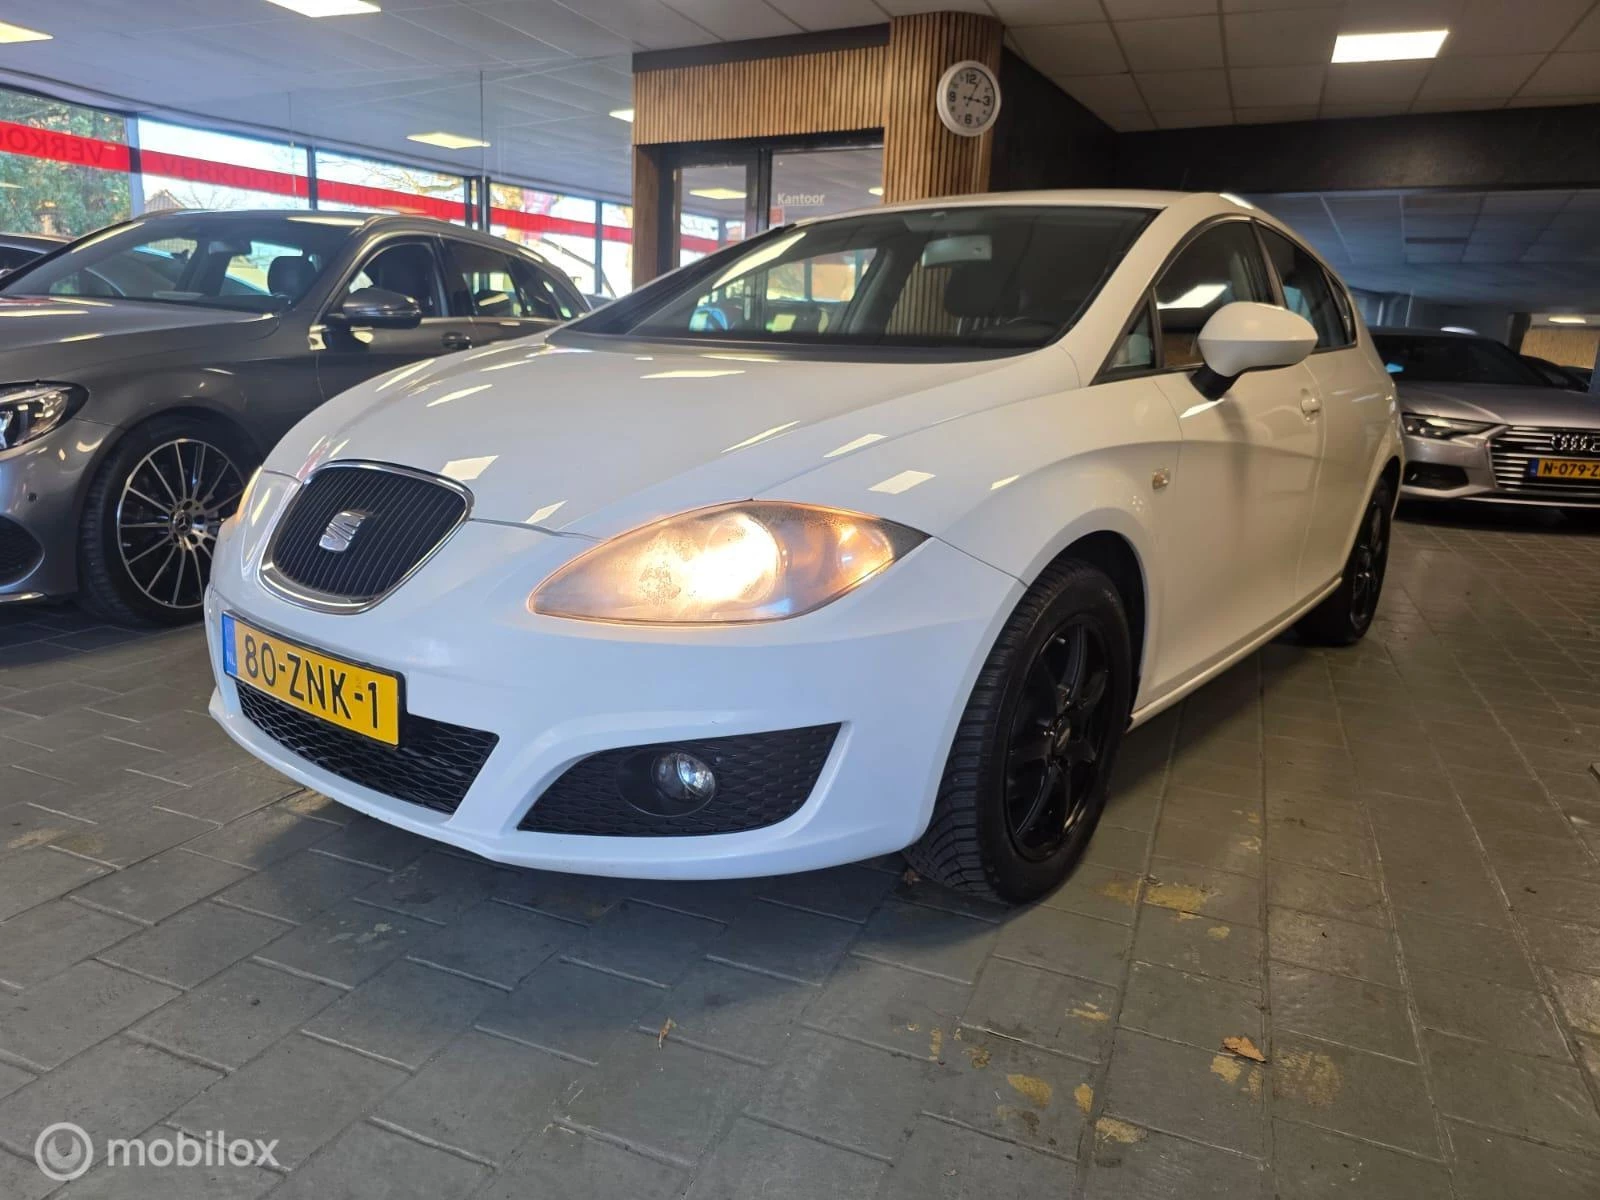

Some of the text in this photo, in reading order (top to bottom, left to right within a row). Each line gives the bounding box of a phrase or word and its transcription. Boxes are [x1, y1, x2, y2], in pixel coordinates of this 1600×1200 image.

[966, 73, 977, 85] 12
[964, 113, 972, 124] 6
[777, 192, 825, 205] Kantoor
[1543, 462, 1600, 477] N-079-Z
[244, 634, 378, 729] 80-ZNK-1
